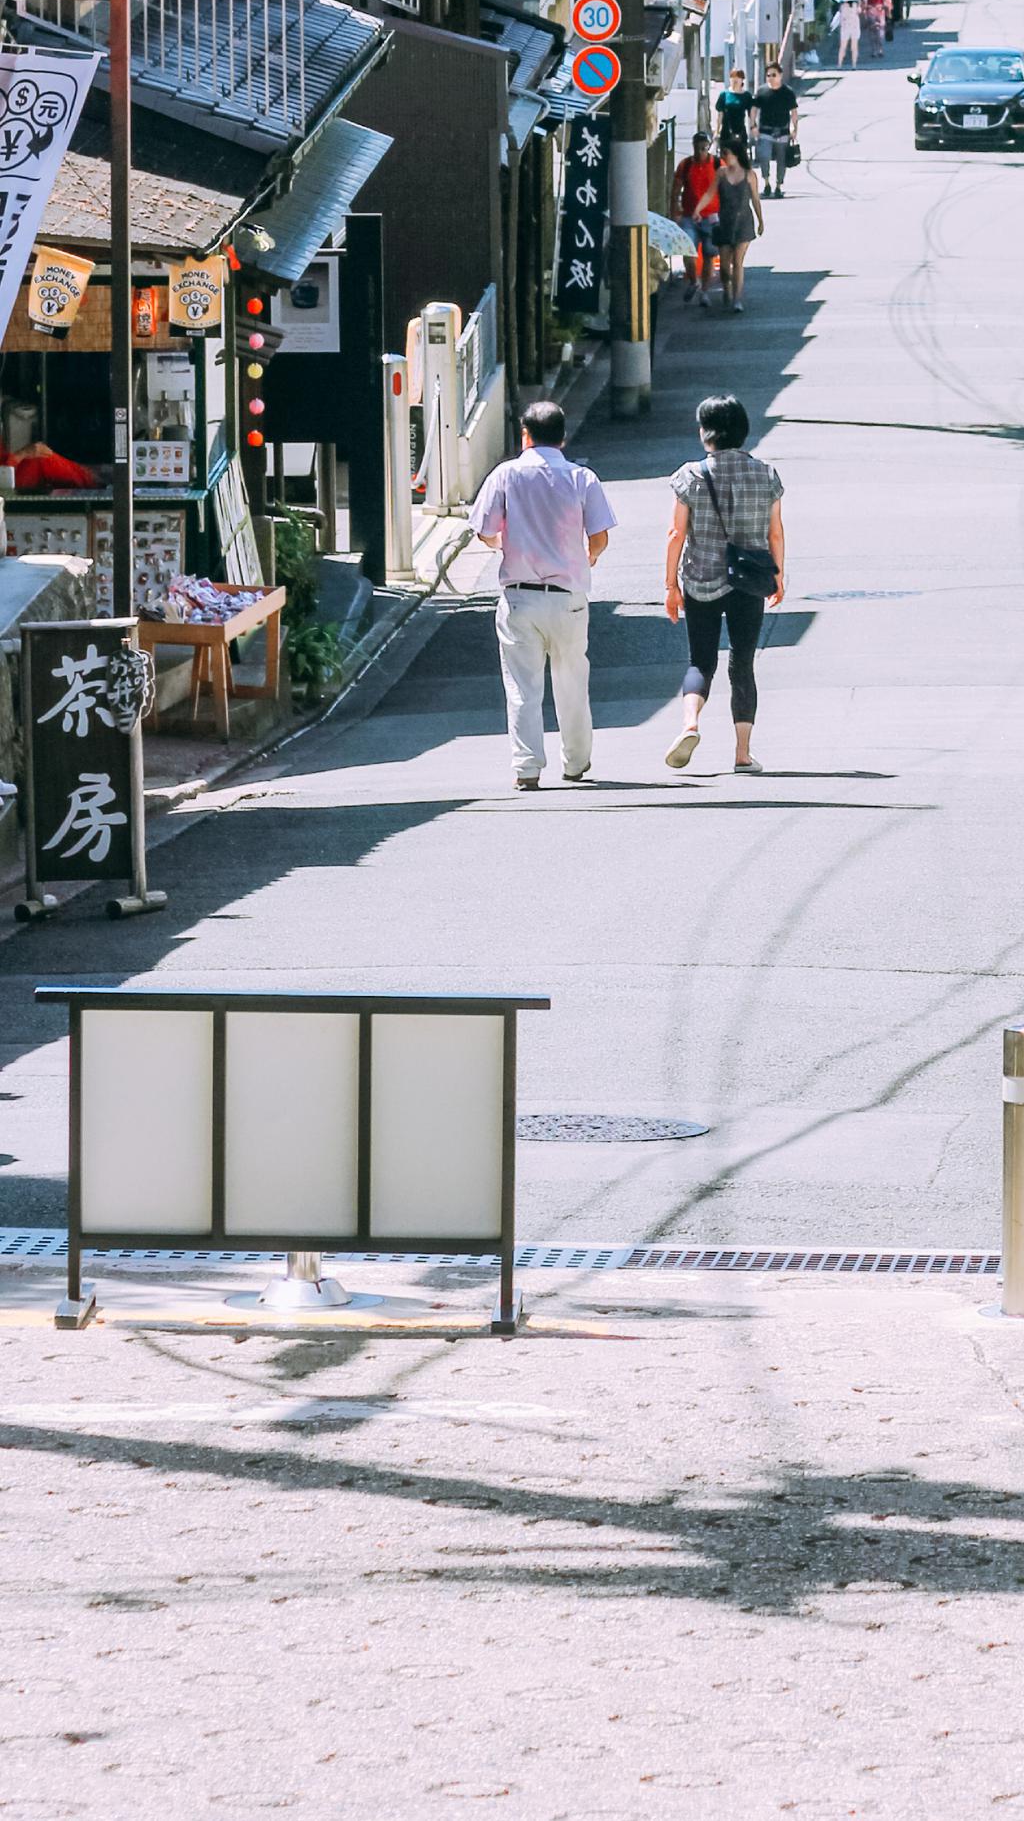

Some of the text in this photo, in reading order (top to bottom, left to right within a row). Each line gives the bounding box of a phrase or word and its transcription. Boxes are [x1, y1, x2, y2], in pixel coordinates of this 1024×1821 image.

[583, 6, 609, 28] 30
[38, 100, 59, 119] 元
[46, 266, 76, 280] MONEY
[181, 271, 211, 280] MONEY
[34, 274, 80, 298] EXCHANGE
[172, 280, 219, 295] EXCHANGE
[107, 653, 137, 734] お弁当
[37, 644, 128, 863] 茶房
